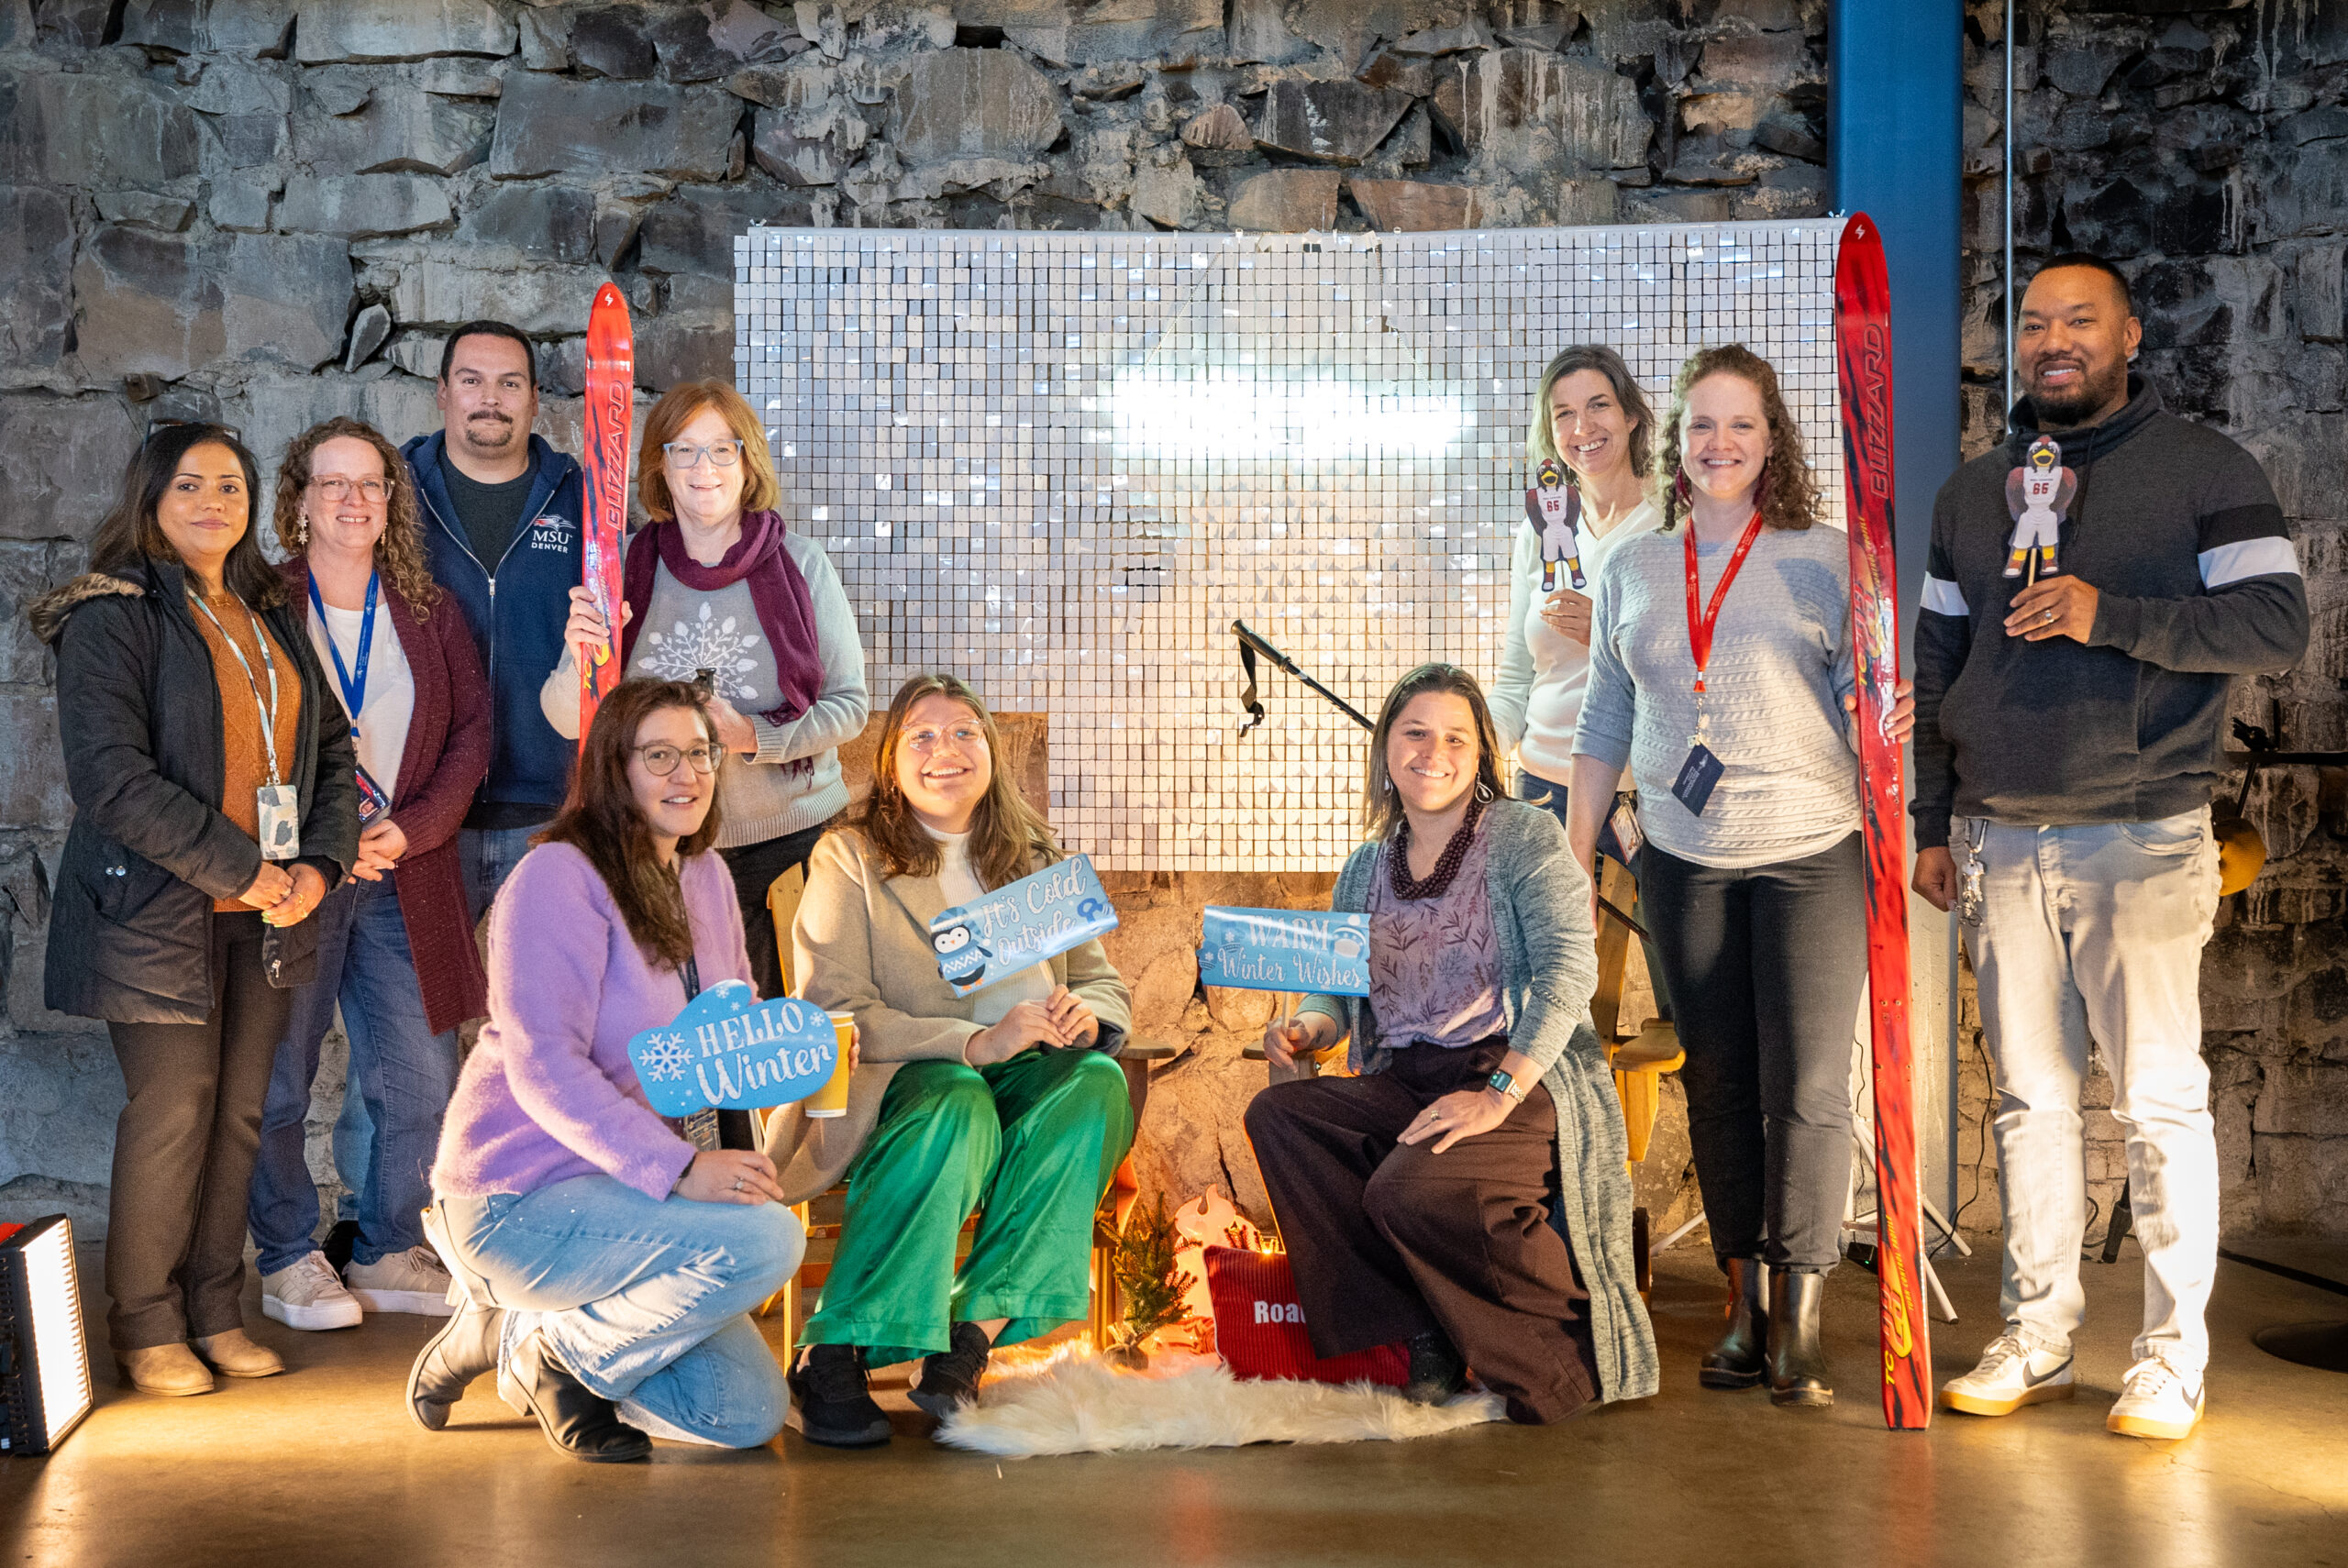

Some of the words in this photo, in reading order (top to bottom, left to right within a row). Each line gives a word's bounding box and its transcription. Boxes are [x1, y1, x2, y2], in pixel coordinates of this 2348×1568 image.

[531, 542, 569, 554] DENVER
[532, 529, 570, 545] MSU
[584, 659, 593, 690] TC
[1857, 652, 1867, 686] TC
[980, 893, 1021, 936] It's
[1026, 856, 1087, 914] Cold
[997, 910, 1078, 966] Outside
[1247, 914, 1330, 951] WARM
[1217, 946, 1286, 982] Winter
[1292, 951, 1364, 988] Wishes
[695, 1001, 804, 1058] HELLO
[695, 1043, 833, 1106] Winter
[1885, 1214, 1899, 1250] PROFILE
[1895, 1252, 1909, 1287] CONTROL
[1884, 1349, 1896, 1386] TC
